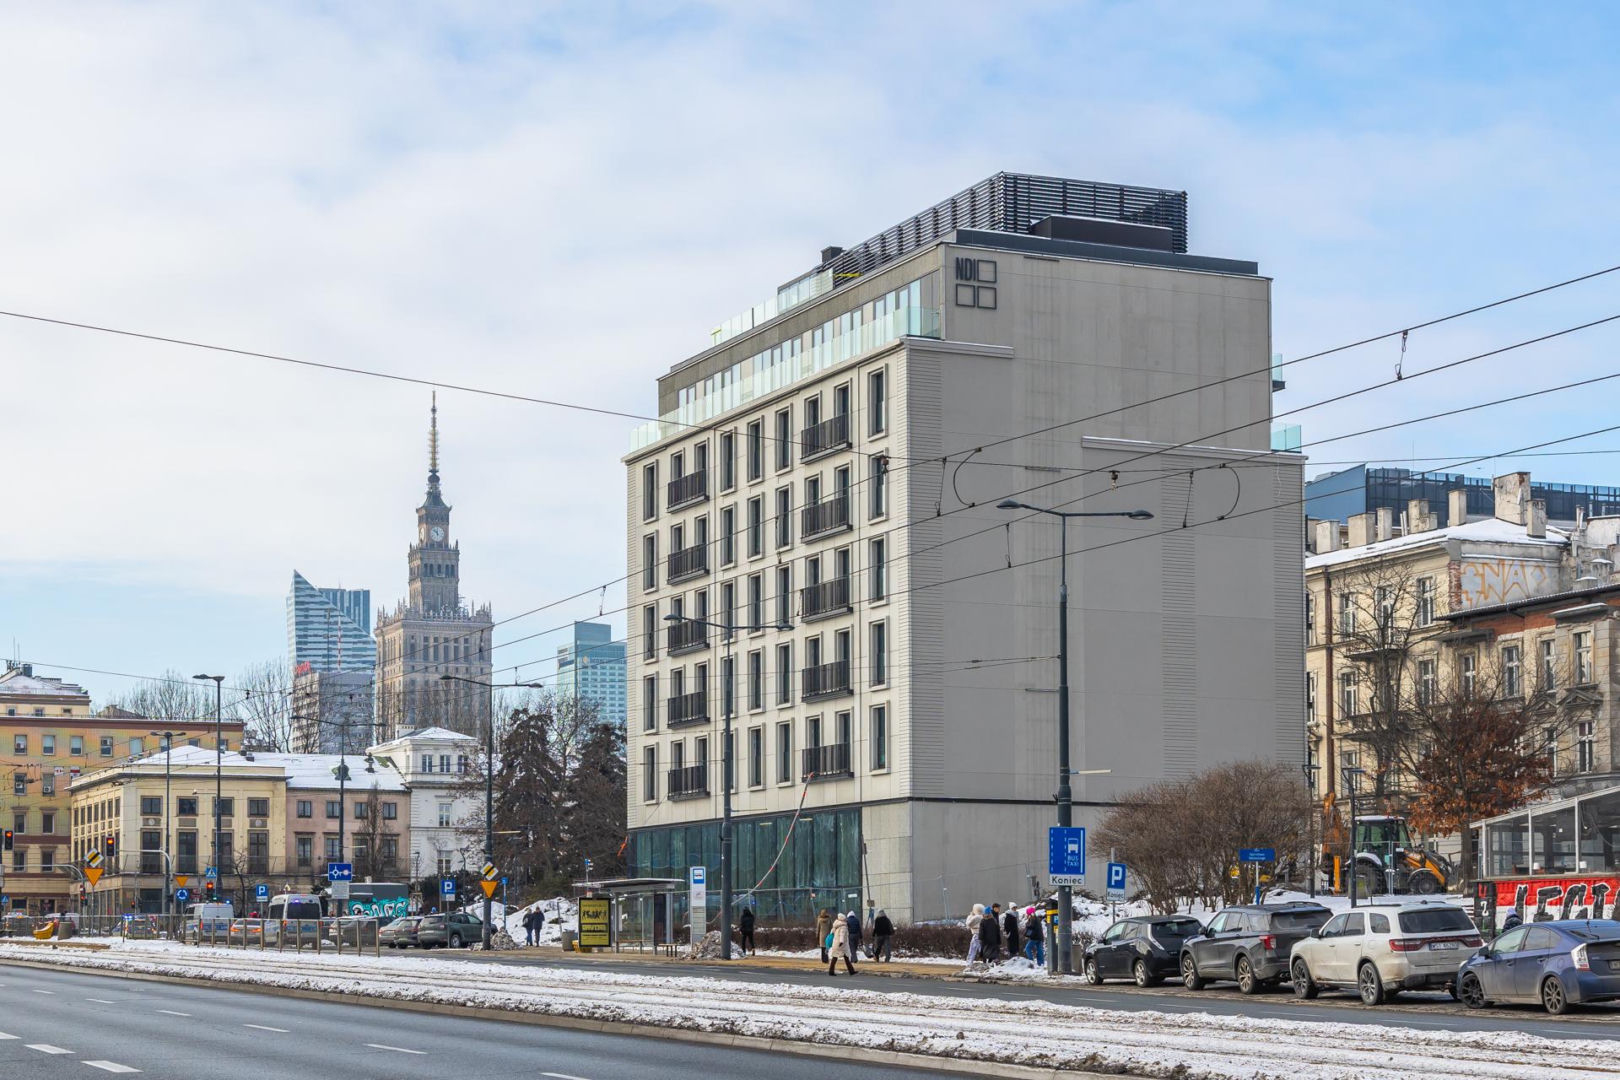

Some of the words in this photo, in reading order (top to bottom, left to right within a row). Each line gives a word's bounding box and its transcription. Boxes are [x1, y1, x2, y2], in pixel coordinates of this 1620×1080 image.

[956, 257, 976, 281] NDI
[1052, 876, 1082, 884] Koniec
[1111, 866, 1123, 885] P
[258, 886, 266, 895] P
[444, 881, 453, 893] P
